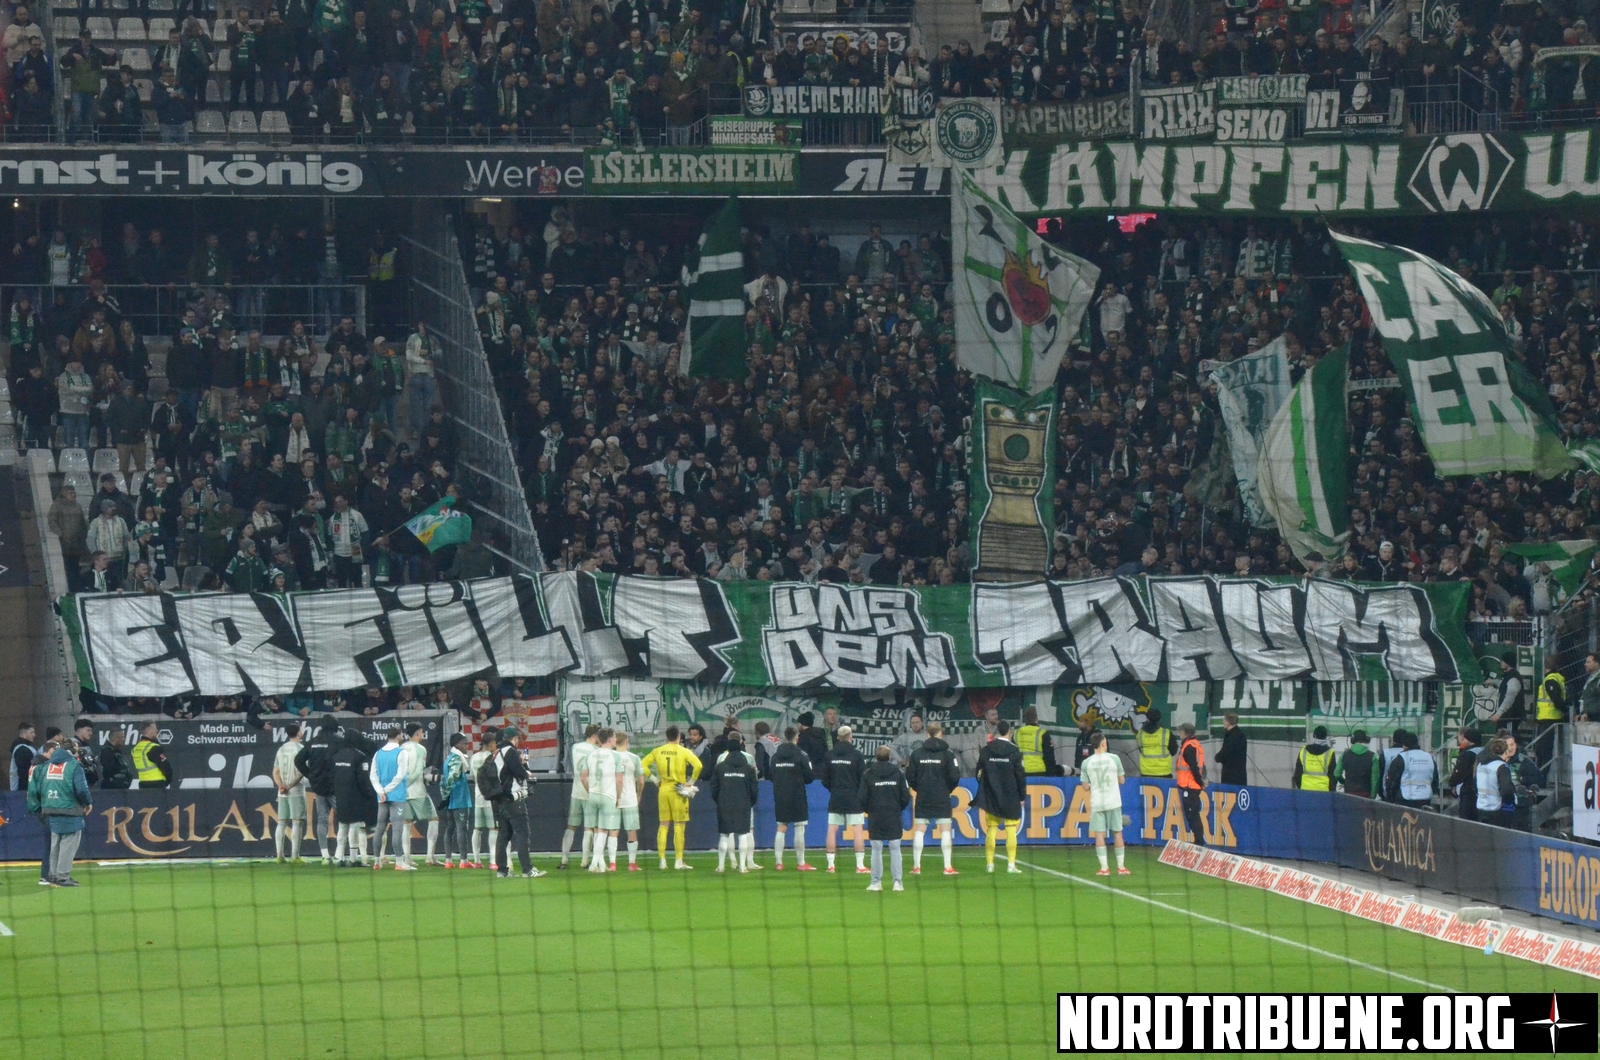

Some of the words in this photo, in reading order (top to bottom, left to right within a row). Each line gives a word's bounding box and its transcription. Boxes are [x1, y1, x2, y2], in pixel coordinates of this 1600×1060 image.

[1216, 109, 1287, 141] SEKO
[188, 154, 363, 192] könig
[590, 153, 794, 184] ISELERSHEIM
[974, 142, 1400, 212] KÄMPFEN
[772, 585, 917, 636] UNS
[974, 578, 1438, 685] TRAUM
[764, 628, 957, 689] DEN
[724, 698, 764, 716] Bremen
[187, 734, 257, 745] Schwarzwald
[200, 724, 230, 734] Made
[231, 724, 245, 733] im
[665, 757, 671, 778] 1
[1094, 766, 1112, 789] 14
[47, 789, 59, 799] 21
[1355, 891, 1402, 925] WeberHaus
[1400, 902, 1446, 936] WeberHaus
[1498, 926, 1554, 964] WeberHaus
